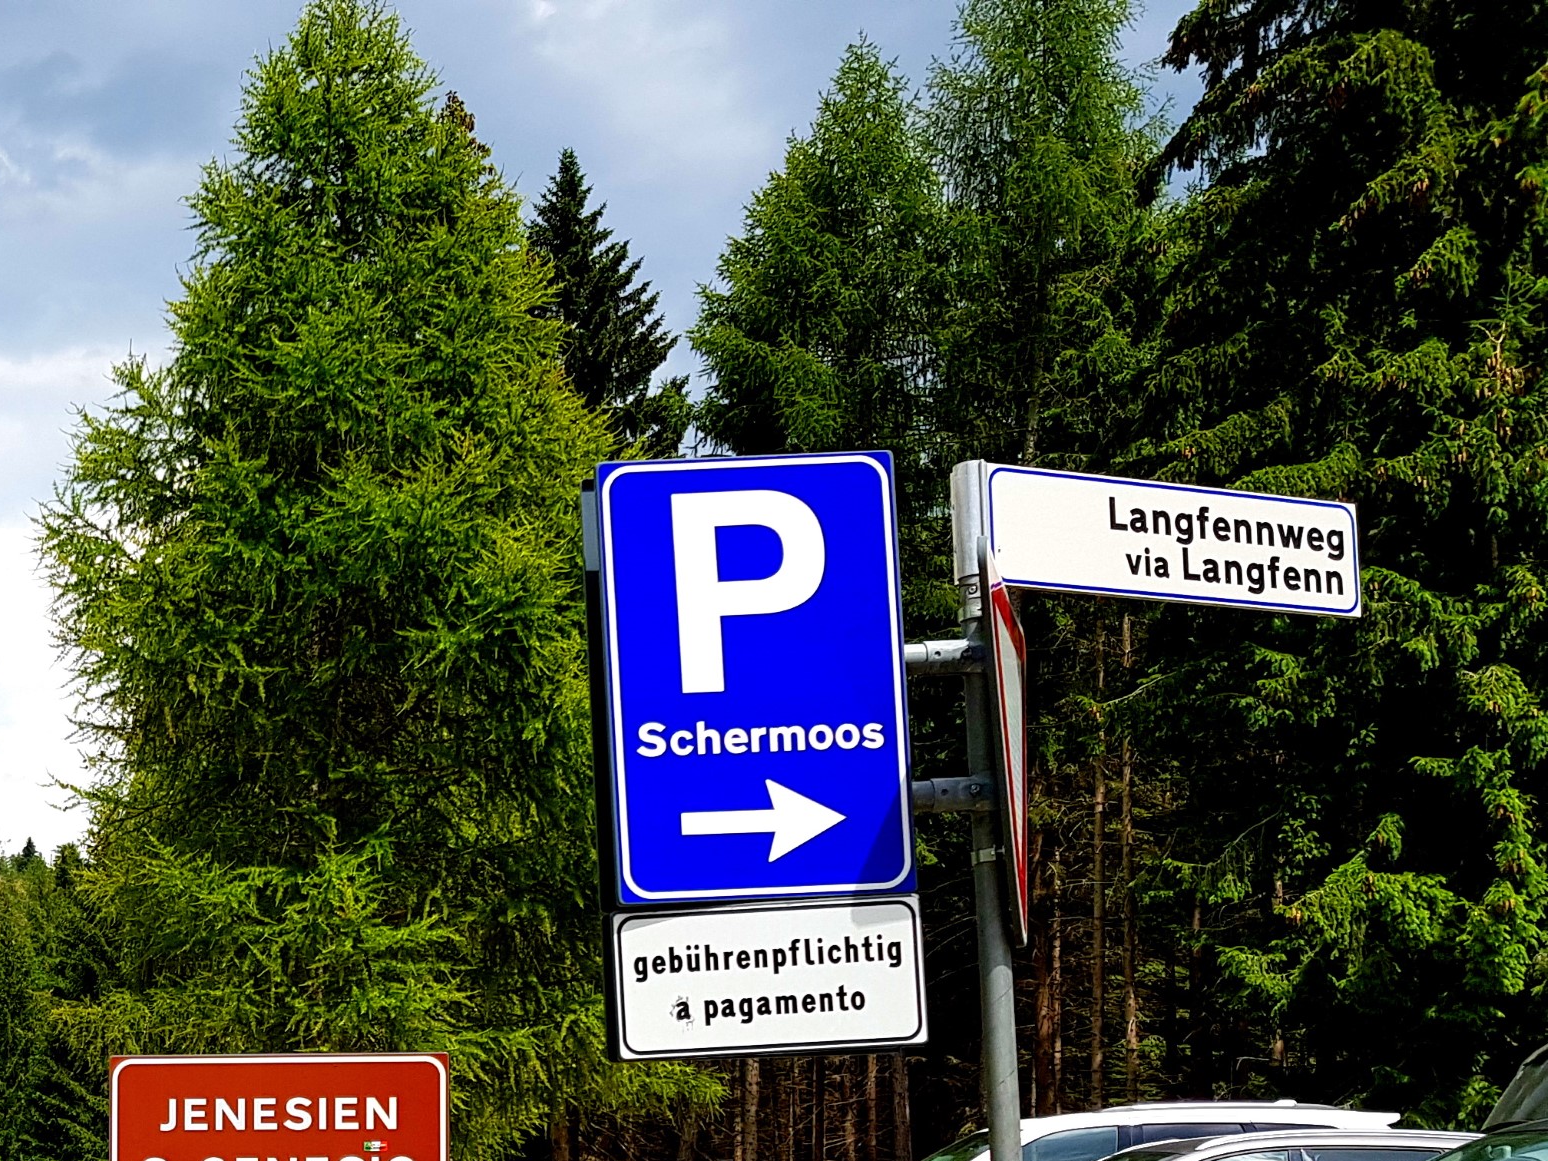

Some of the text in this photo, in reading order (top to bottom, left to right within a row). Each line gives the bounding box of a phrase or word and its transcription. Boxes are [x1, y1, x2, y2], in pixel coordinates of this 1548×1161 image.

[1108, 496, 1345, 561] Langfennweg
[670, 489, 826, 694] P
[1125, 546, 1345, 596] via Langfenn
[636, 720, 885, 758] Schermoos
[633, 934, 903, 983] gebührenpflichtig
[704, 984, 867, 1027] pagamento
[159, 1096, 399, 1132] JENESIEN
